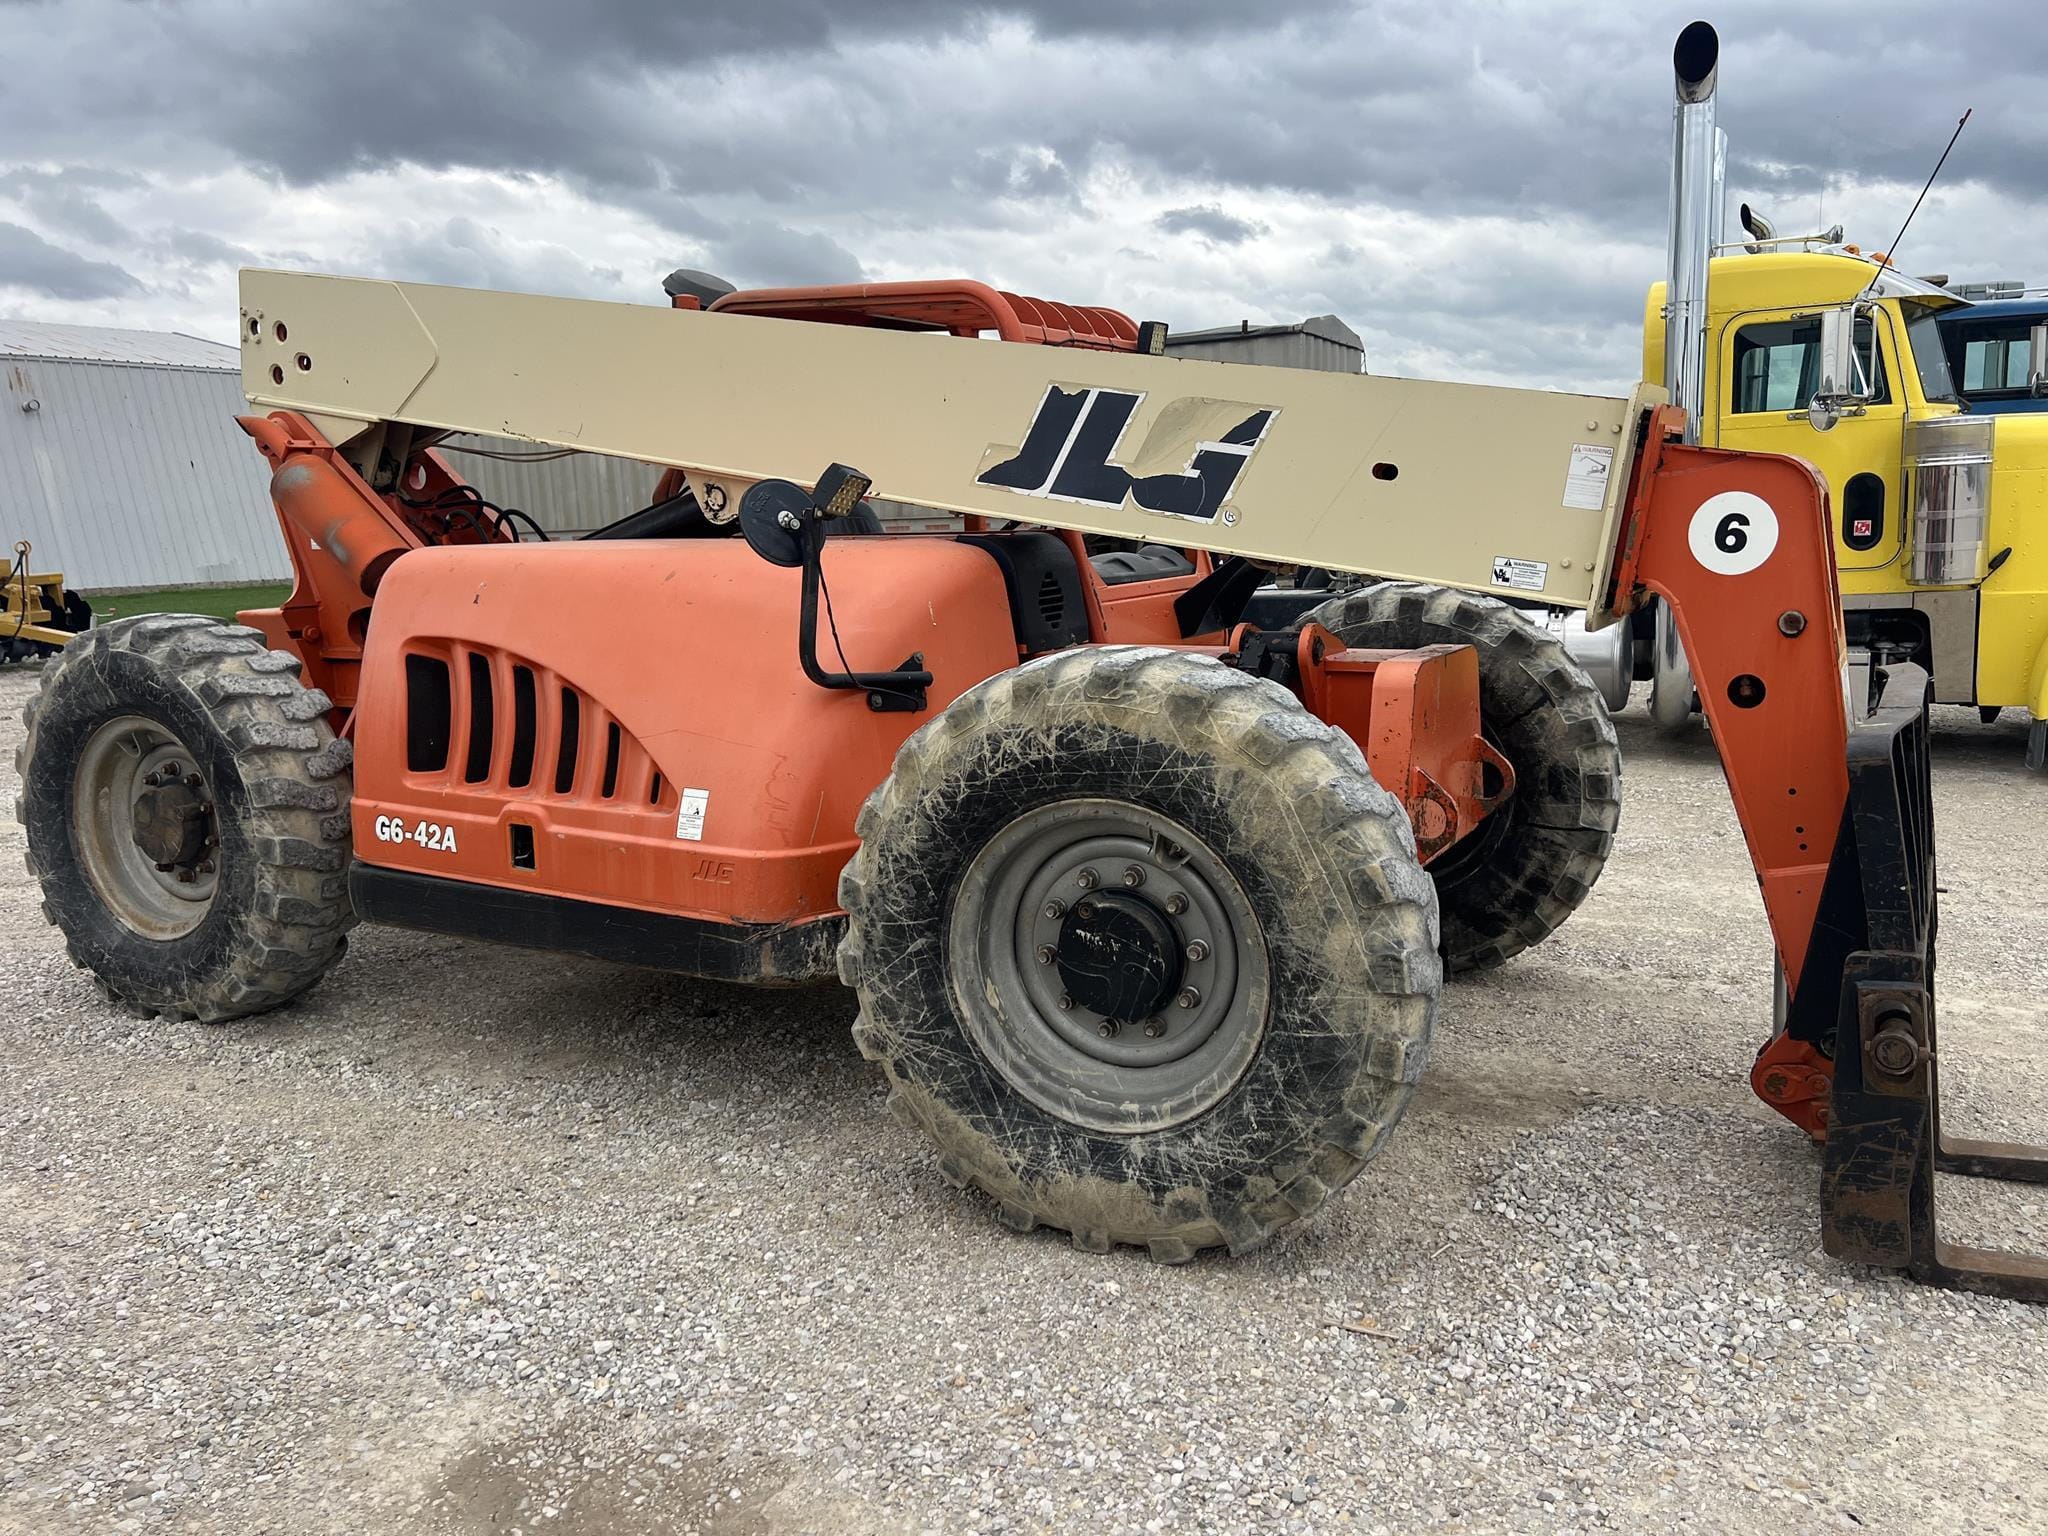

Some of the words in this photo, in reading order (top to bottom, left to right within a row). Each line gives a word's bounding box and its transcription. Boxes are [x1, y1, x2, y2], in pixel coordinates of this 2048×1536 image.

[1714, 513, 1750, 553] 6
[1513, 561, 1538, 569] WARNING
[375, 814, 457, 853] G6-42A
[692, 859, 735, 884] JLG
